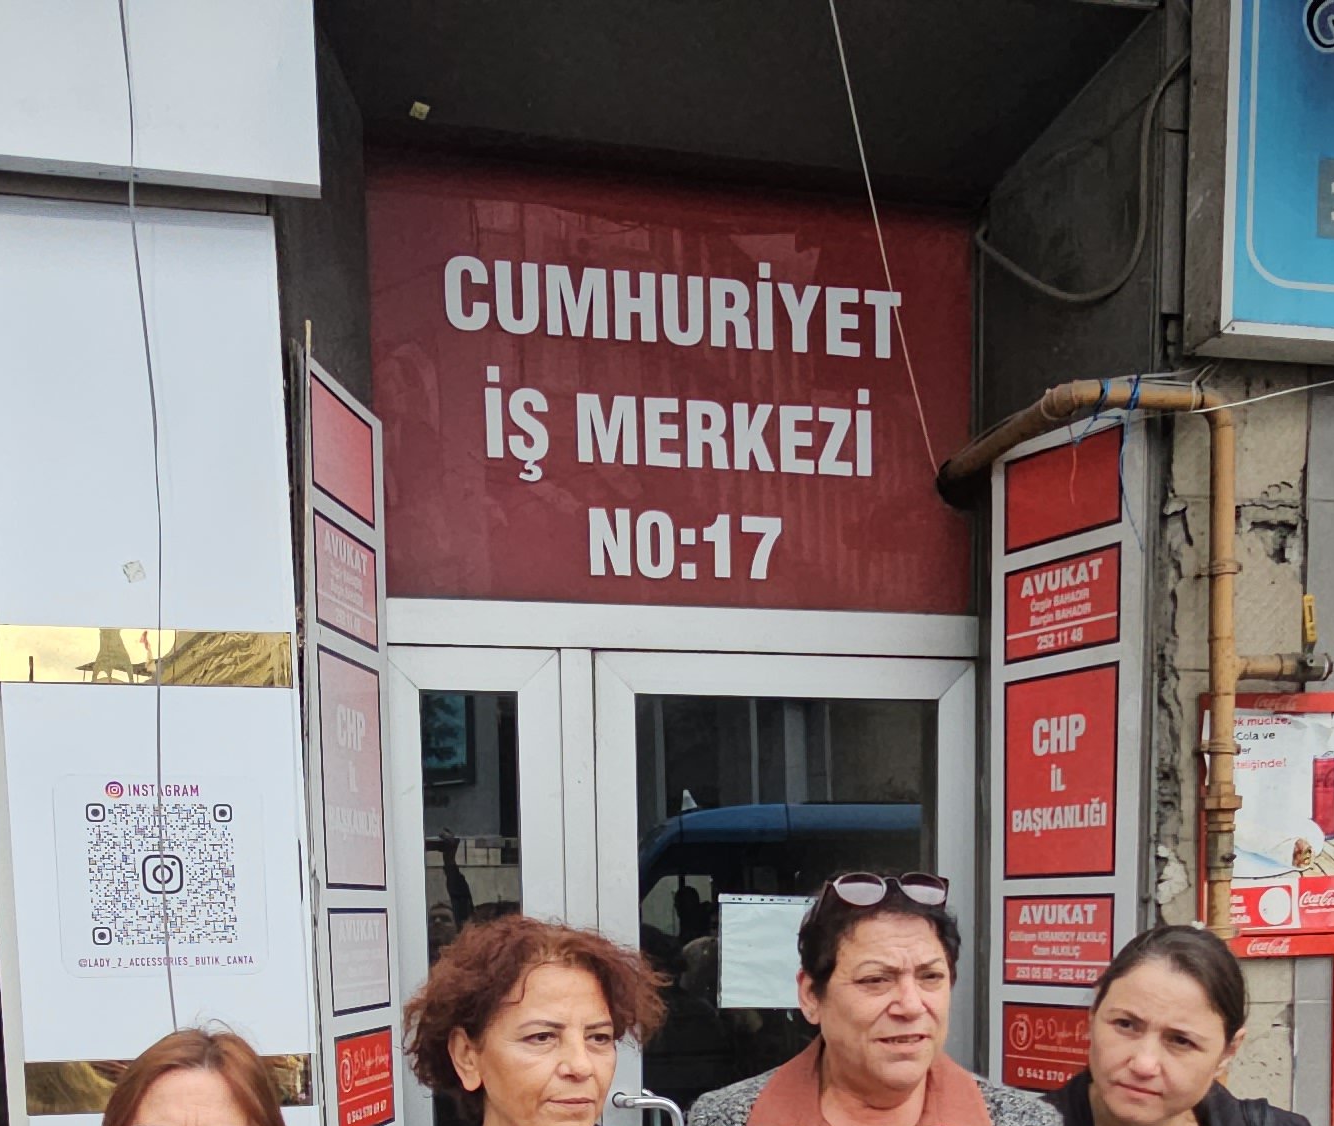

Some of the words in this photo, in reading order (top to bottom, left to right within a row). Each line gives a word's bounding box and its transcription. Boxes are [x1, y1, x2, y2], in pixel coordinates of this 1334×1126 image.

[444, 255, 902, 359] CUMHURİYET
[483, 365, 550, 483] İŞ
[575, 388, 873, 477] MERKEZİ
[587, 507, 783, 581] NO:17
[1020, 558, 1103, 599] AVUKAT
[336, 703, 366, 753] CHP
[1032, 713, 1087, 757] CHP
[1261, 731, 1276, 740] ve
[1050, 763, 1067, 793] İL
[1011, 797, 1108, 838] BAŞKANLIĞI
[1019, 904, 1097, 925] AVUKAT
[1246, 937, 1292, 957] Coca-Cola
